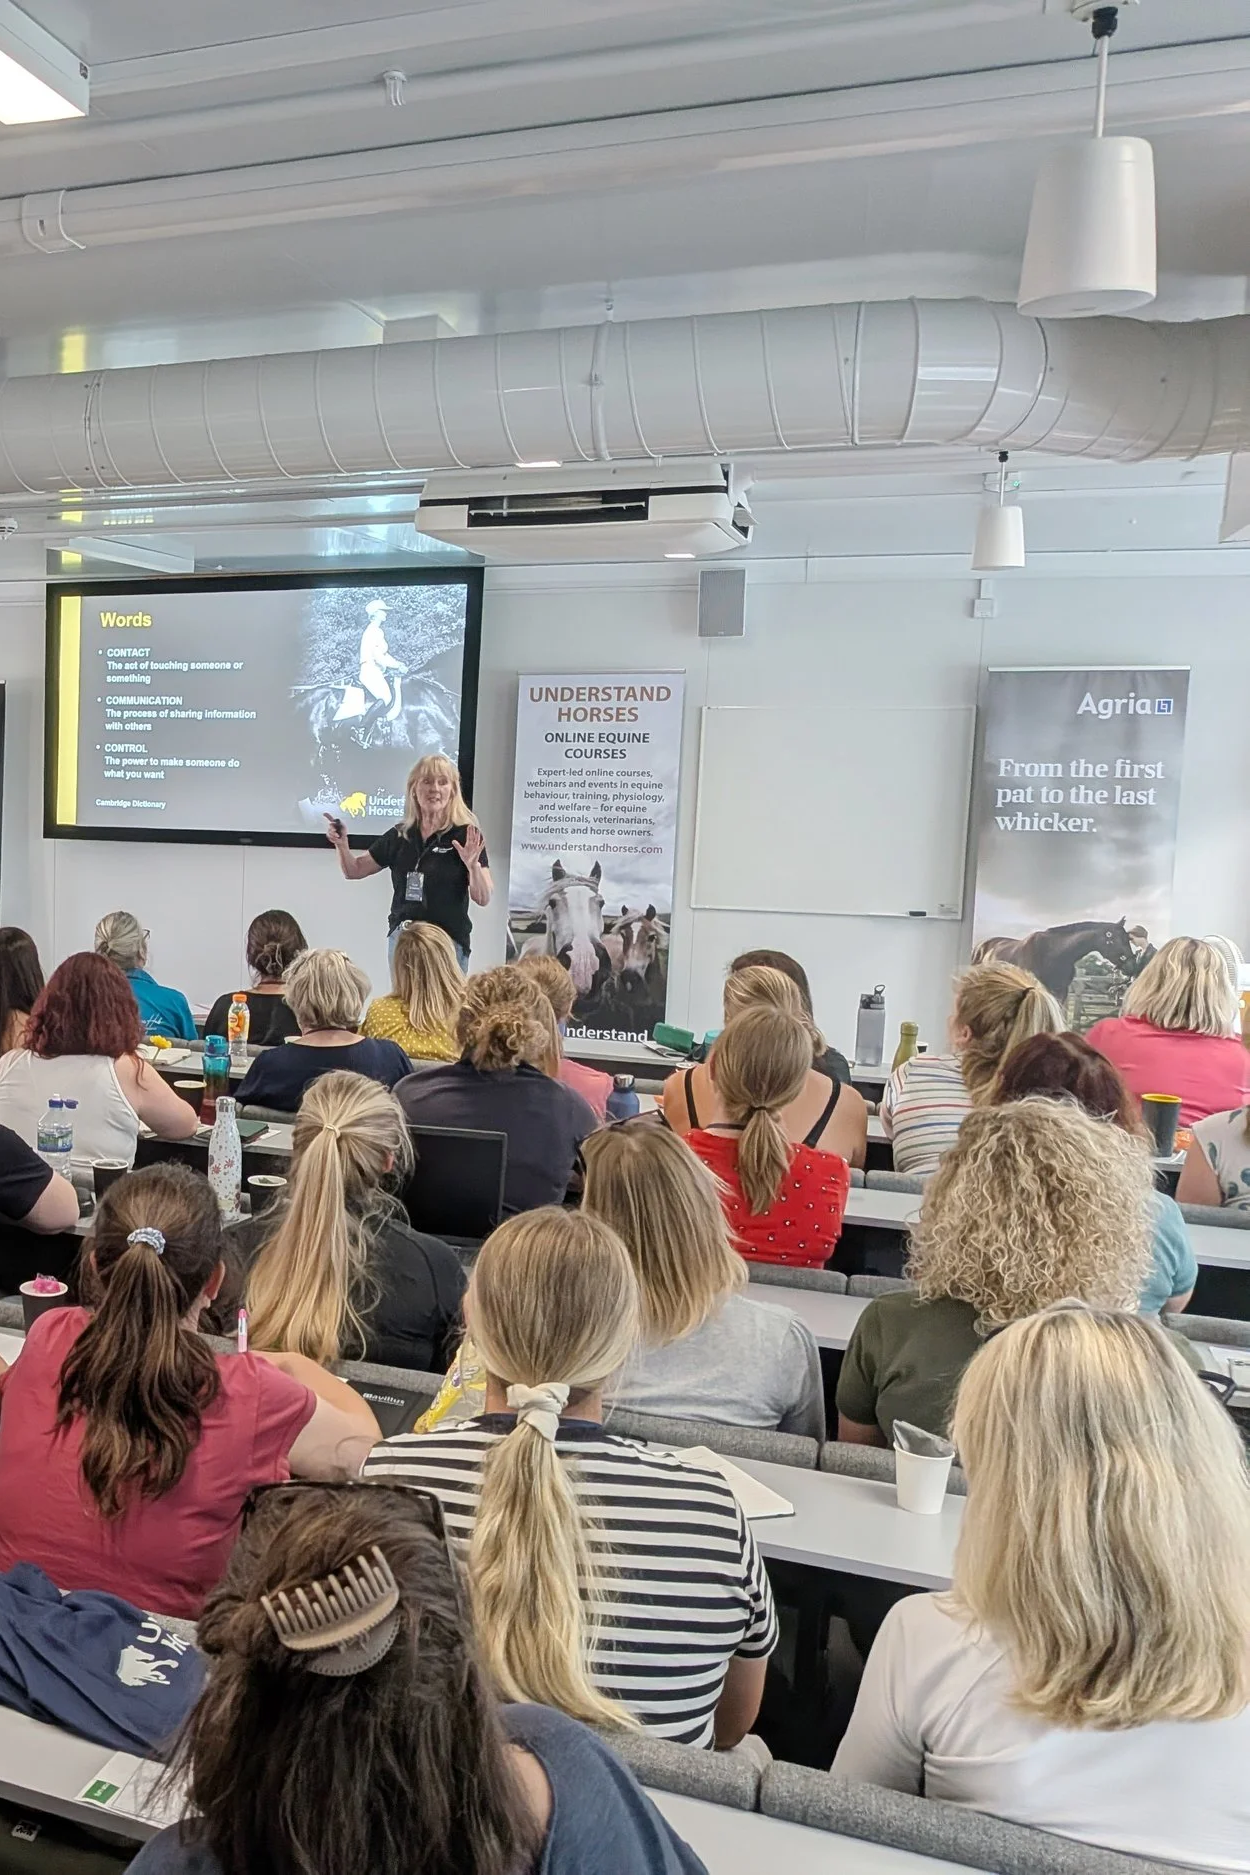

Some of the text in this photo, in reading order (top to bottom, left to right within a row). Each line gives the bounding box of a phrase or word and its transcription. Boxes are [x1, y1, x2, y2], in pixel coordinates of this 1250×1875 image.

[100, 612, 152, 627] Words
[107, 648, 150, 657] CONTACT
[107, 661, 243, 671] The act of touching someone or
[106, 674, 151, 684] something
[529, 686, 672, 702] UNDERSTAND
[106, 696, 182, 705] COMMUNICATION
[1077, 692, 1152, 720] Agria
[106, 709, 256, 720] The process of sharing information
[557, 707, 639, 723] HORSES
[105, 722, 152, 731] with others
[544, 732, 650, 744] ONLINE EQUINE
[105, 743, 148, 753] CONTROL
[564, 748, 627, 760] COURSES
[105, 756, 240, 767] The power to make someone do
[537, 768, 653, 778] Expert-led online courses,
[998, 758, 1165, 779] From the first
[104, 769, 164, 780] what you want
[527, 779, 663, 790] webinars and events in equine
[524, 791, 665, 803] behaviour, training, physiology,
[995, 785, 1157, 808] pat to the last
[95, 799, 166, 809] Cambridge Dictionary
[538, 803, 556, 811] and
[558, 803, 591, 812] welfare
[600, 804, 614, 812] for
[615, 804, 647, 814] equine
[530, 815, 655, 825] professionals, veterinarians,
[995, 812, 1097, 832] whicker.
[530, 826, 654, 837] students and horse owners.
[521, 842, 663, 854] www.understandhorses.com
[565, 1025, 648, 1042] nderstand
